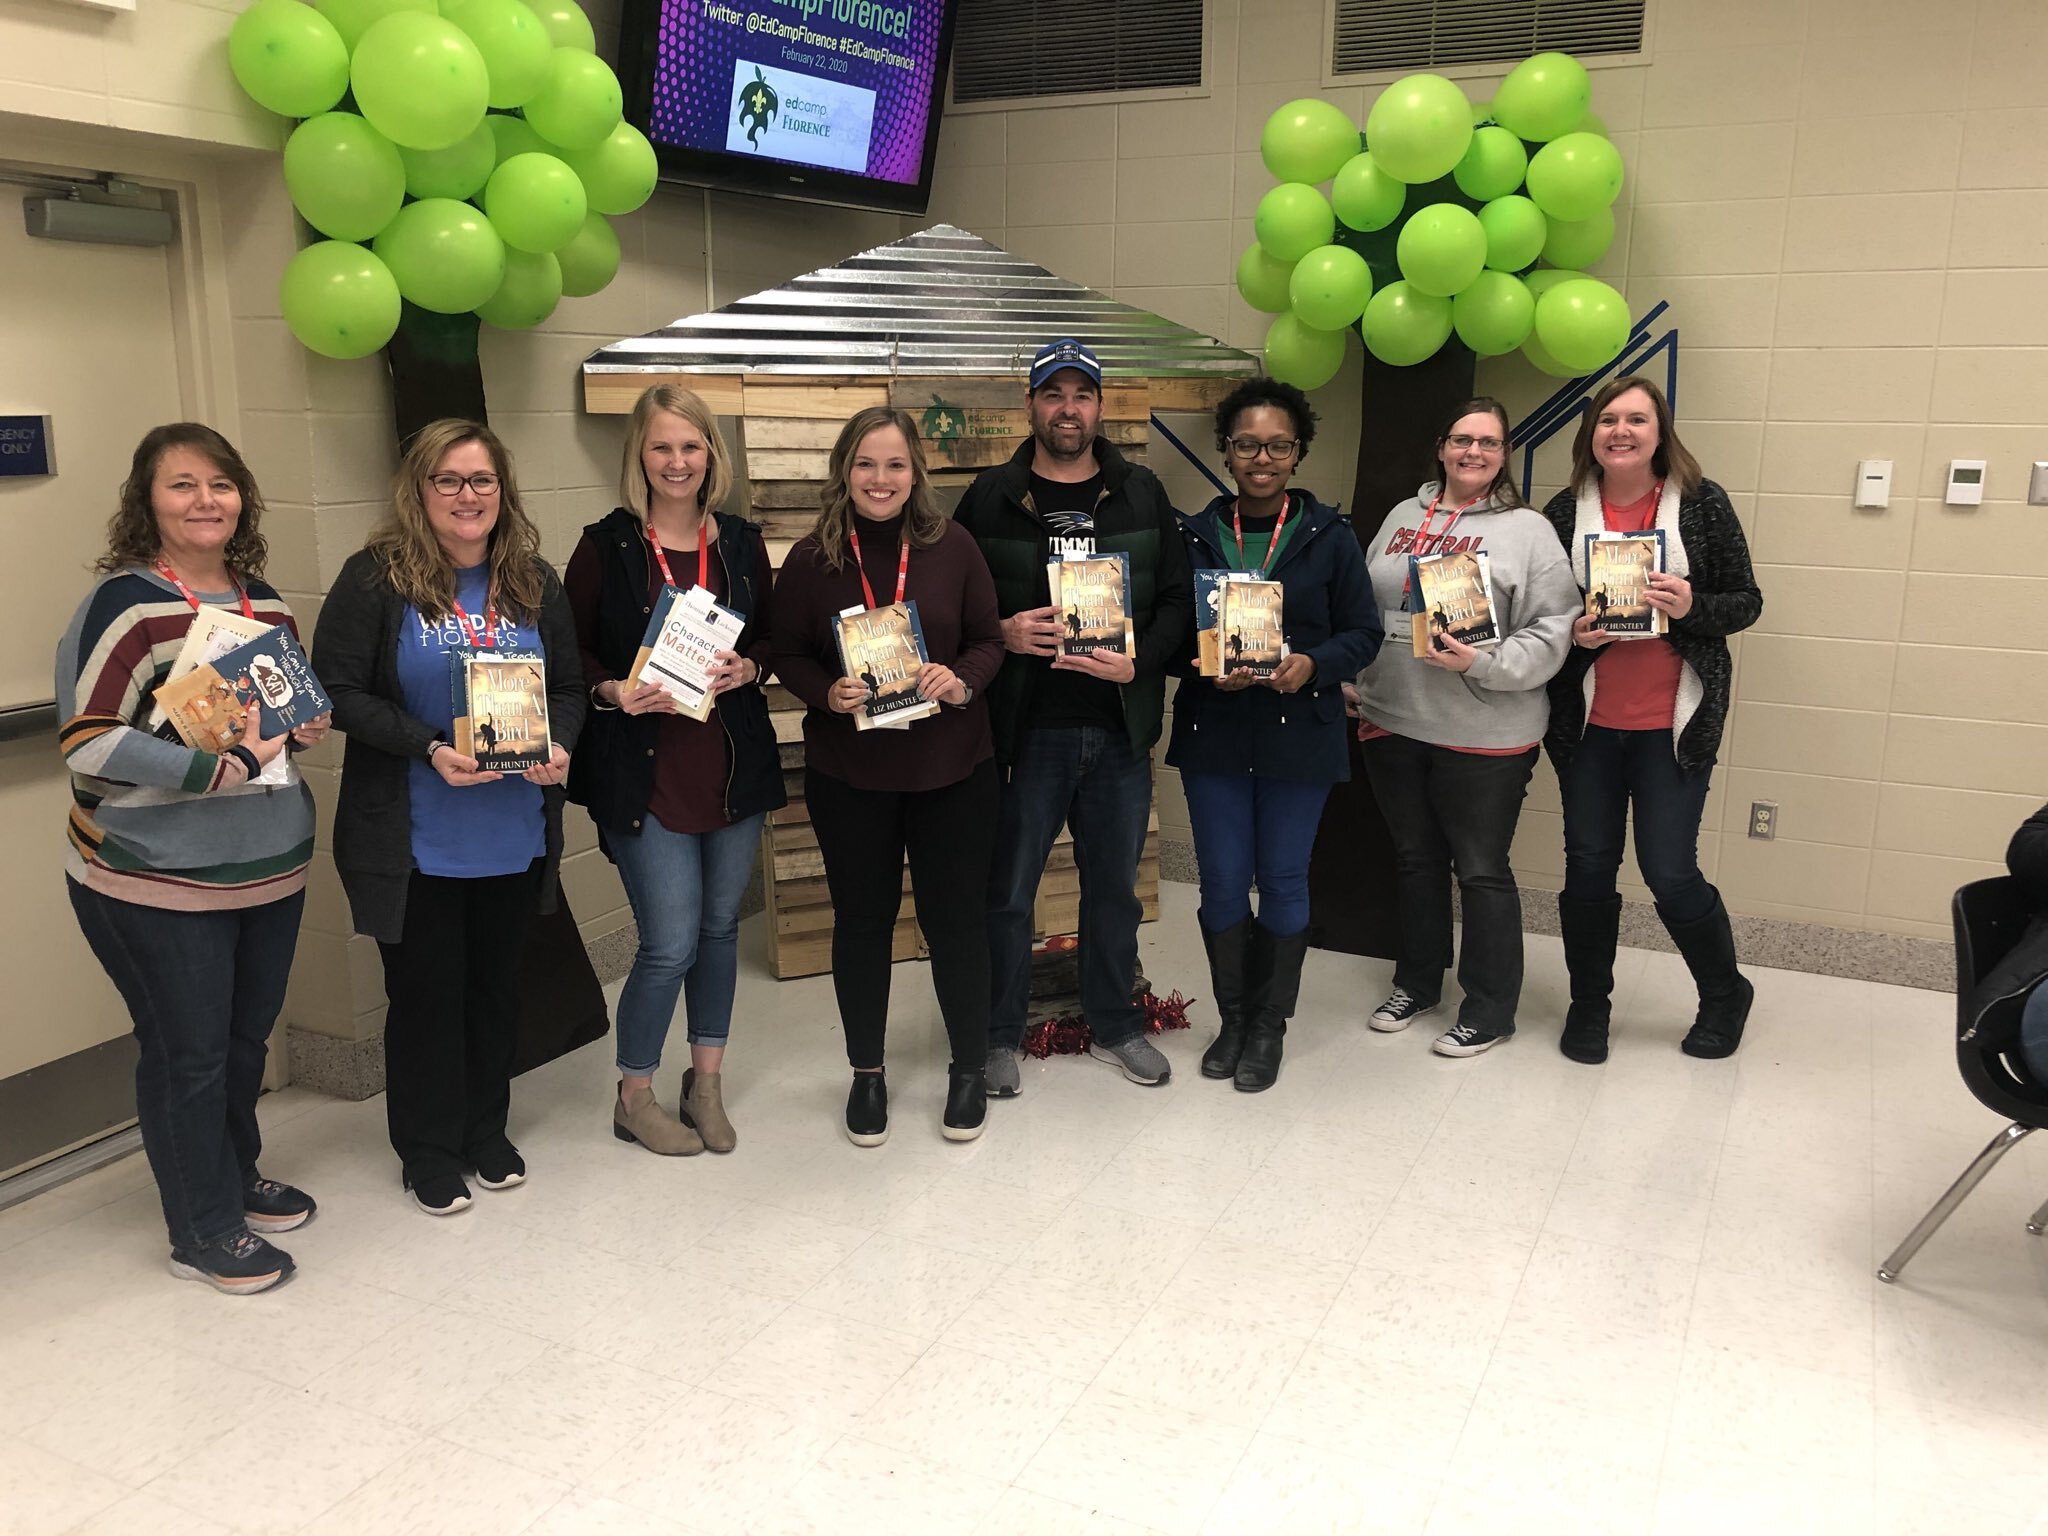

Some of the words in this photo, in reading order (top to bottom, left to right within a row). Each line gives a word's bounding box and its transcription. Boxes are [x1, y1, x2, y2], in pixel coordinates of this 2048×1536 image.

[703, 1, 744, 27] Twitter:
[746, 12, 837, 51] @EdCampFlorence
[839, 37, 915, 71] #EdCampFlorence
[781, 46, 814, 68] February
[814, 54, 828, 71] 22,
[828, 57, 848, 74] 2020
[785, 97, 827, 116] edcamp
[782, 115, 831, 137] FLORENCE
[968, 411, 1006, 423] edcamp
[969, 425, 1013, 435] FLORENCE
[1, 443, 32, 455] ONLY
[1604, 545, 1643, 565] More
[1073, 565, 1111, 586] More
[1200, 573, 1213, 581] You
[1431, 562, 1470, 583] More
[667, 588, 677, 598] Yo
[1239, 587, 1273, 608] More
[1606, 586, 1637, 607] Bird
[418, 612, 517, 631] WEDN
[1079, 608, 1110, 629] Bird
[1443, 598, 1476, 624] Bird
[856, 618, 897, 641] More
[1610, 622, 1645, 630] HUNTLEY
[670, 621, 721, 655] Characte
[1085, 644, 1119, 653] HTLEY
[1240, 631, 1268, 651] Bird
[457, 650, 474, 660] You
[662, 632, 719, 669] Matters
[276, 632, 288, 651] You
[286, 650, 306, 676] Can't
[303, 675, 324, 709] Teach
[279, 654, 302, 690] THROUGH
[296, 687, 305, 696] A
[487, 668, 531, 693] More
[872, 658, 908, 687] Bird
[1253, 666, 1274, 675] NTLE
[265, 674, 284, 693] RAT
[872, 705, 886, 713] LIZ
[887, 695, 921, 710] HUNTLE
[493, 718, 530, 742] Bird
[485, 761, 500, 770] LIZ
